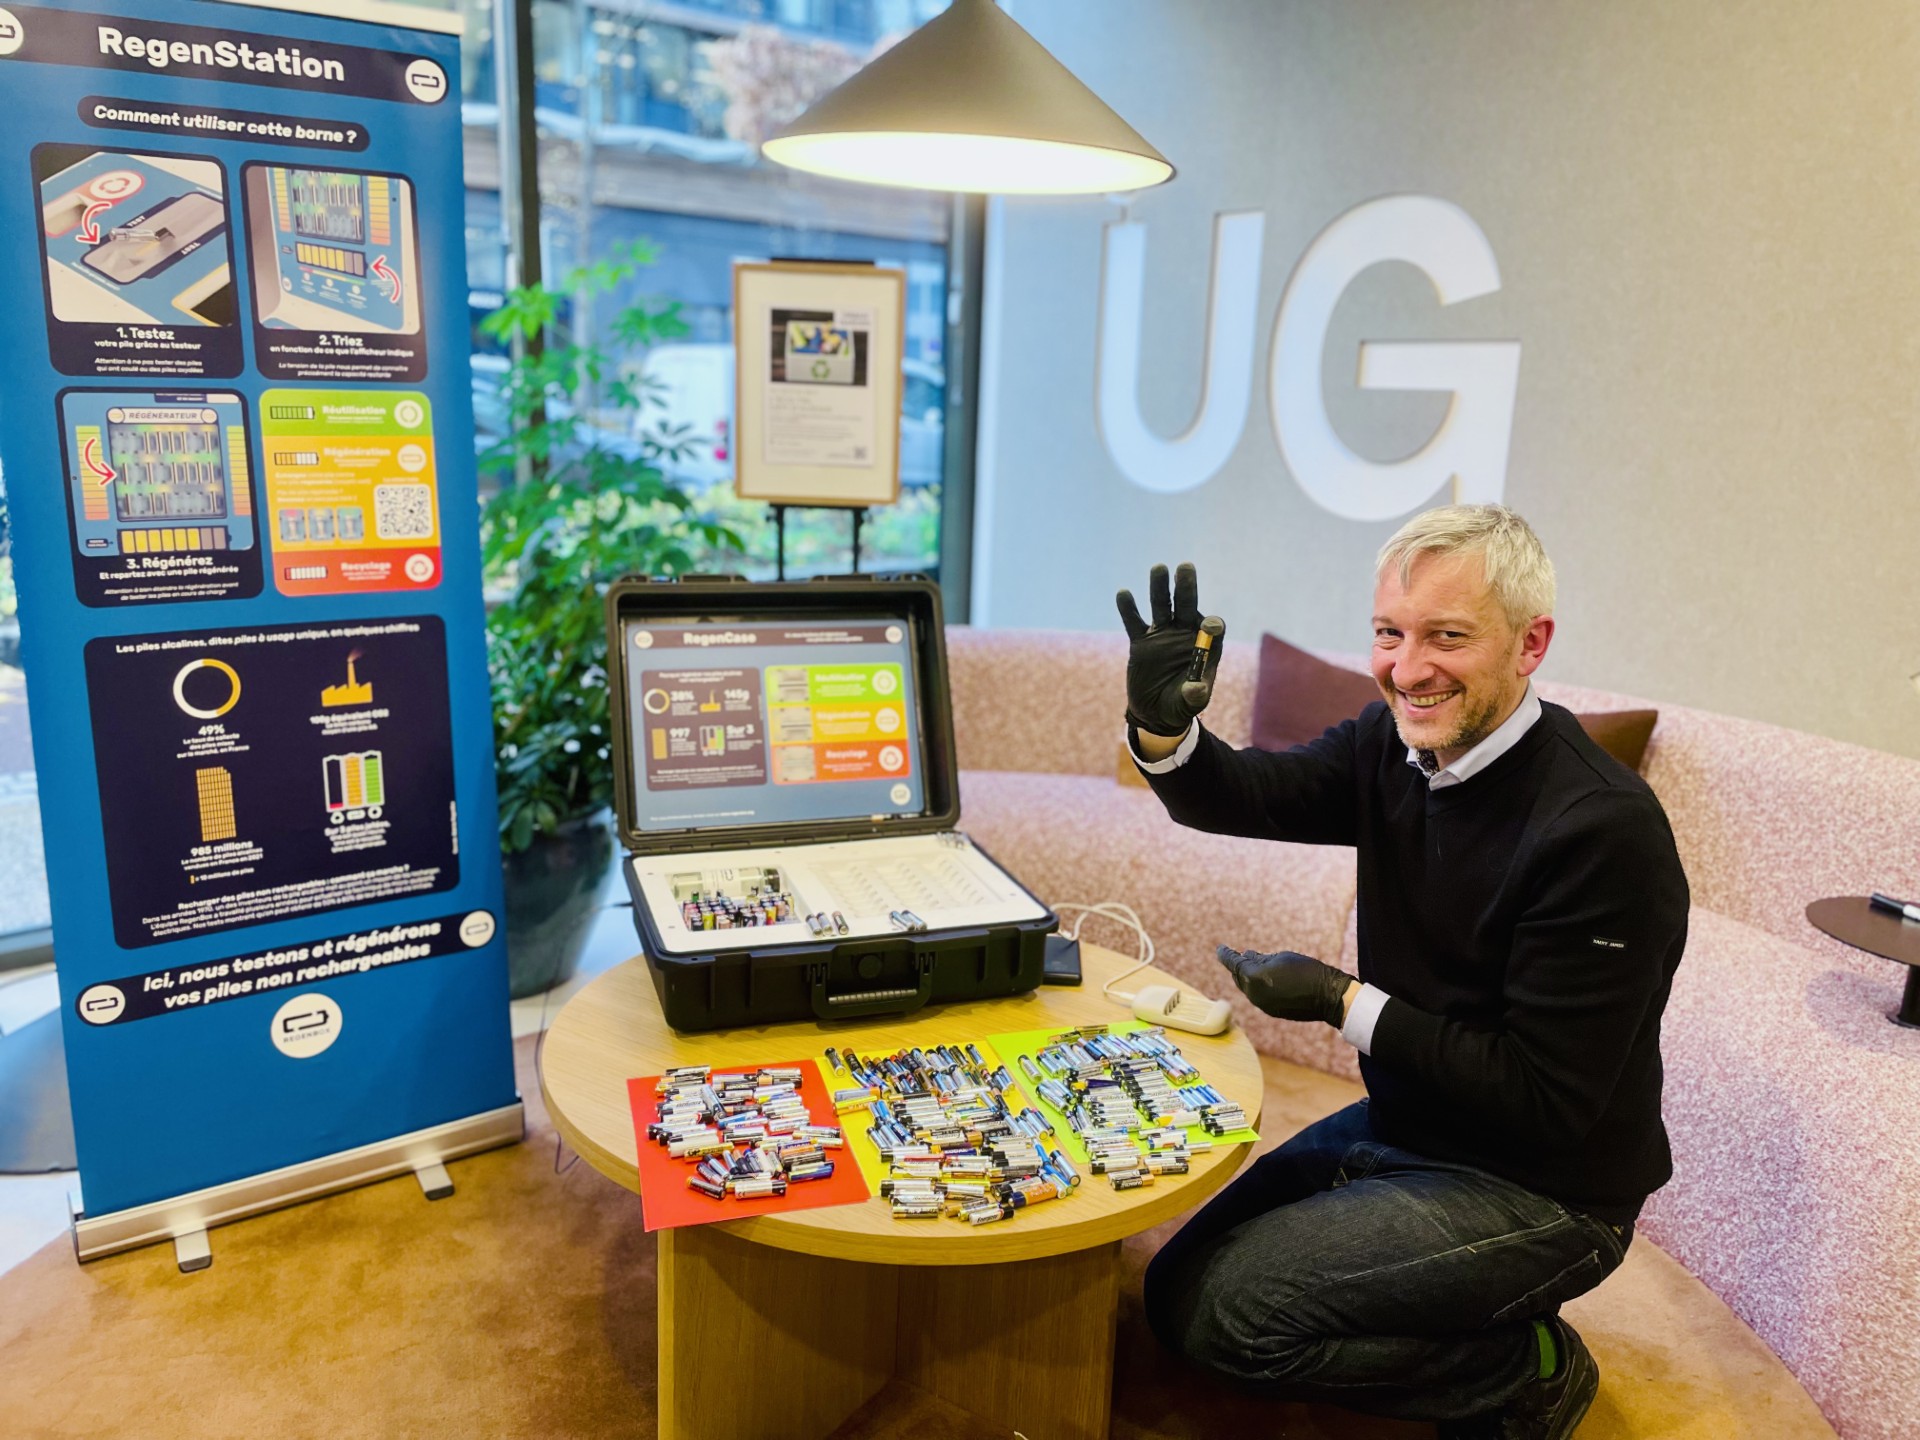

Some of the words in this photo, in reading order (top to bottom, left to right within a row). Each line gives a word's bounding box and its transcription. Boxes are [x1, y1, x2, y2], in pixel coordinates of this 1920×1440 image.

[98, 27, 345, 82] RegenStation
[94, 104, 180, 126] Comment
[183, 113, 245, 132] utiliser
[247, 122, 292, 138] cette
[295, 125, 343, 143] borne
[347, 131, 357, 144] ?
[116, 327, 128, 338] 1.
[129, 327, 175, 340] Testez
[319, 335, 331, 345] 2.
[332, 335, 363, 347] Triez
[95, 340, 117, 348] votre
[119, 340, 134, 349] pile
[135, 341, 159, 349] grâce
[171, 342, 202, 350] testeur
[281, 345, 313, 354] fonction
[314, 346, 323, 354] de
[387, 349, 414, 357] indique
[1097, 192, 1521, 522] UG
[129, 411, 197, 420] RÉGÉNÉRATEUR
[322, 405, 386, 415] Réutilisation
[323, 448, 391, 458] Régénération
[126, 558, 140, 569] 3.
[142, 555, 214, 570] Régénérez
[341, 562, 391, 571] Recyclage
[99, 572, 109, 580] Et
[110, 570, 145, 580] repartez
[183, 568, 198, 576] pile
[199, 565, 239, 575] régénérée
[116, 644, 135, 653] Les
[136, 642, 160, 653] piles
[208, 636, 233, 646] dites
[234, 634, 257, 645] piles
[266, 632, 295, 642] usage
[683, 631, 757, 647] RegenCase
[198, 723, 225, 736] 49%
[213, 840, 254, 853] millions
[178, 897, 220, 910] Recharger
[221, 895, 235, 903] des
[236, 892, 255, 902] piles
[256, 888, 271, 897] non
[144, 972, 175, 992] Ici,
[179, 963, 229, 984] nous
[232, 948, 309, 973] testons
[312, 940, 333, 958] et
[335, 922, 441, 953] régénérons
[164, 990, 201, 1008] vos
[204, 980, 253, 1004] piles
[256, 971, 293, 990] non
[296, 943, 431, 982] rechargeables
[283, 1028, 330, 1043] REGENBOX
